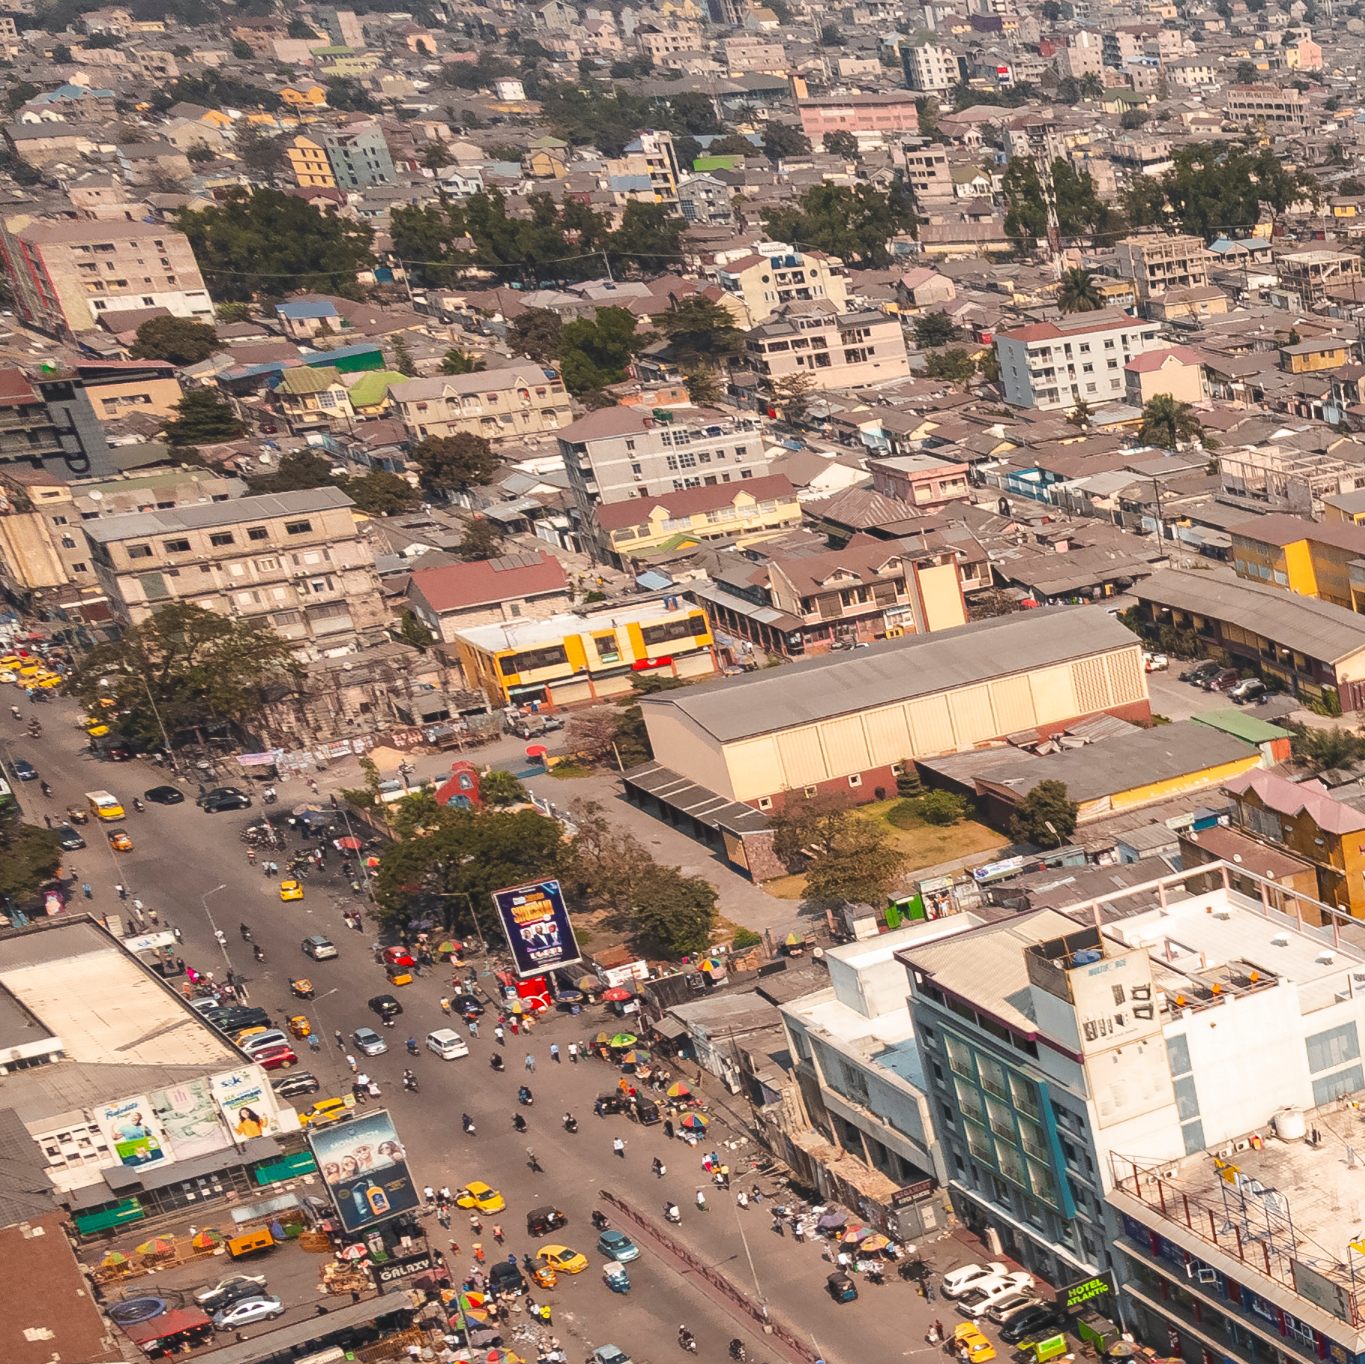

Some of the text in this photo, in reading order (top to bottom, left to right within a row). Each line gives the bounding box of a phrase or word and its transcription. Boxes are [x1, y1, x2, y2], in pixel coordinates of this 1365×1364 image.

[380, 1259, 430, 1281] GALAXY
[1066, 1284, 1109, 1307] ATLANTIC
[1067, 1278, 1104, 1298] HOTEL
